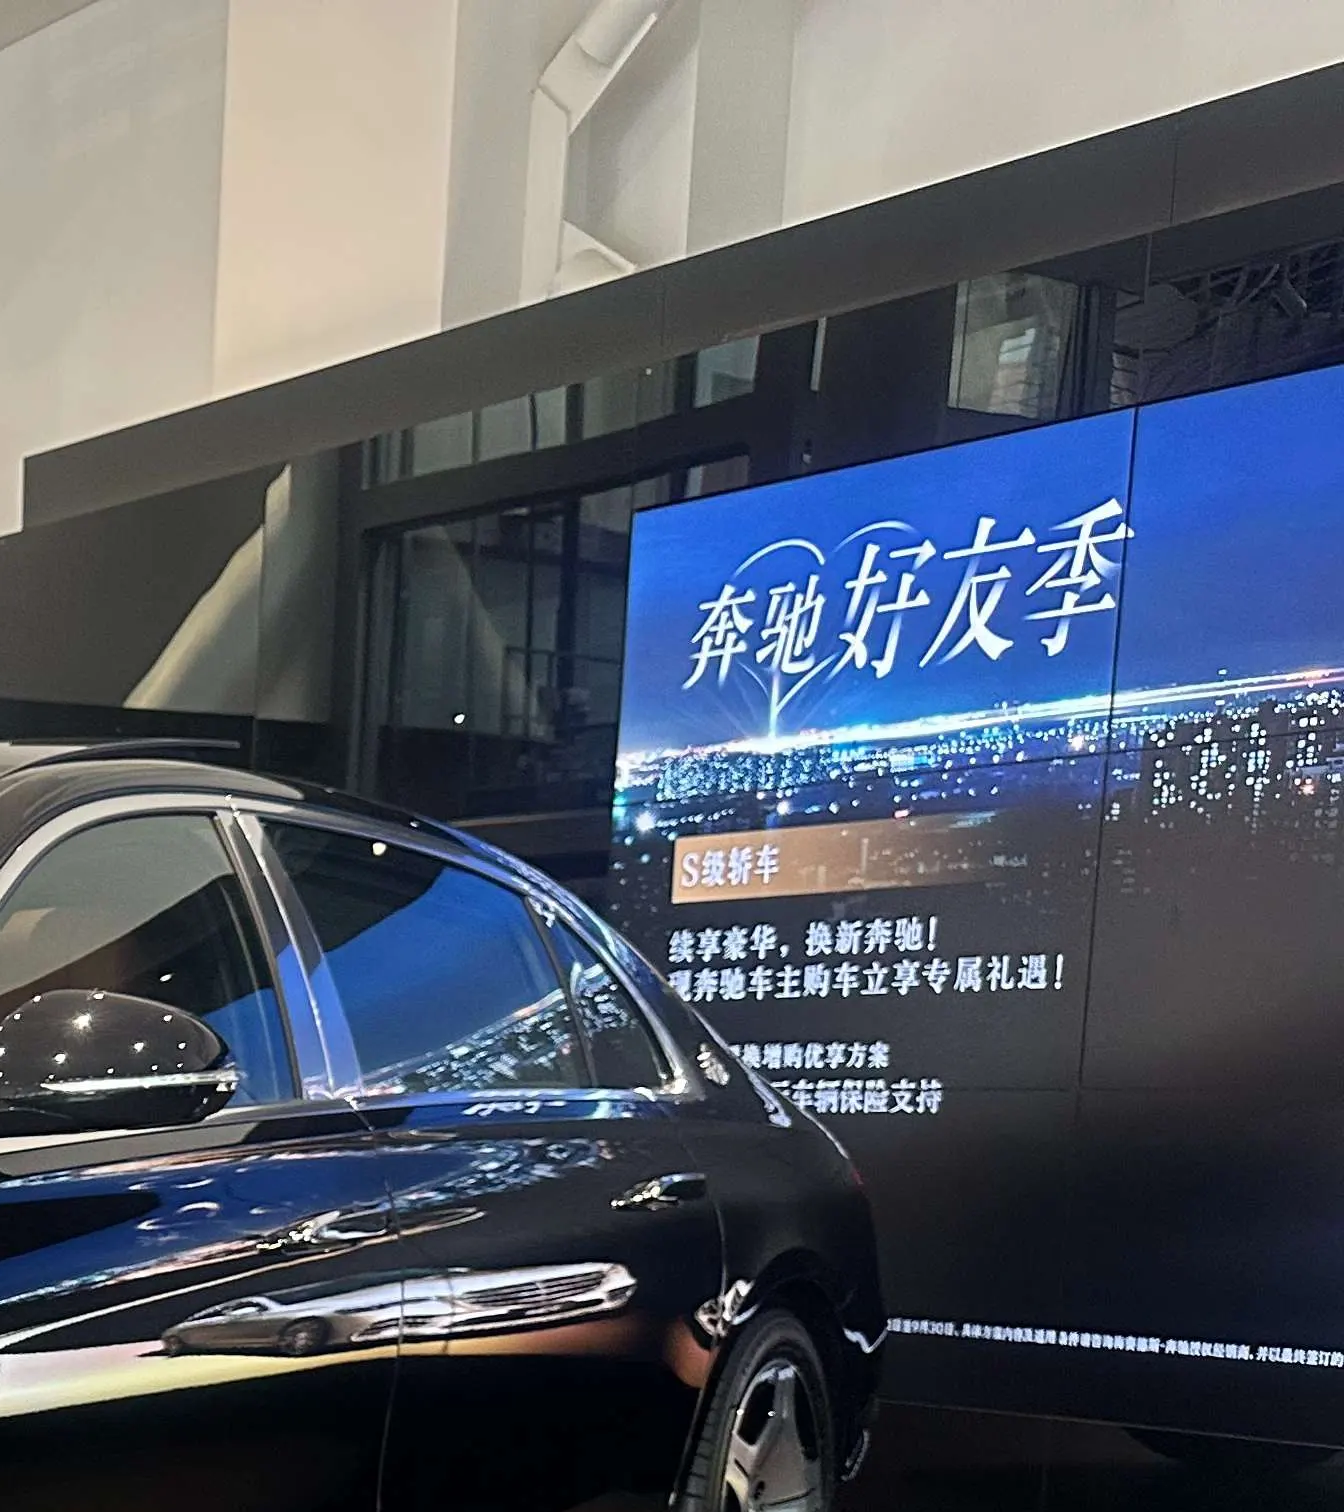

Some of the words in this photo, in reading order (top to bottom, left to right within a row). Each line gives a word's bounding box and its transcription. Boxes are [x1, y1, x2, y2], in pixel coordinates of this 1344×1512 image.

[683, 498, 1135, 690] 奔驰好友季
[681, 844, 781, 888] S级轿车
